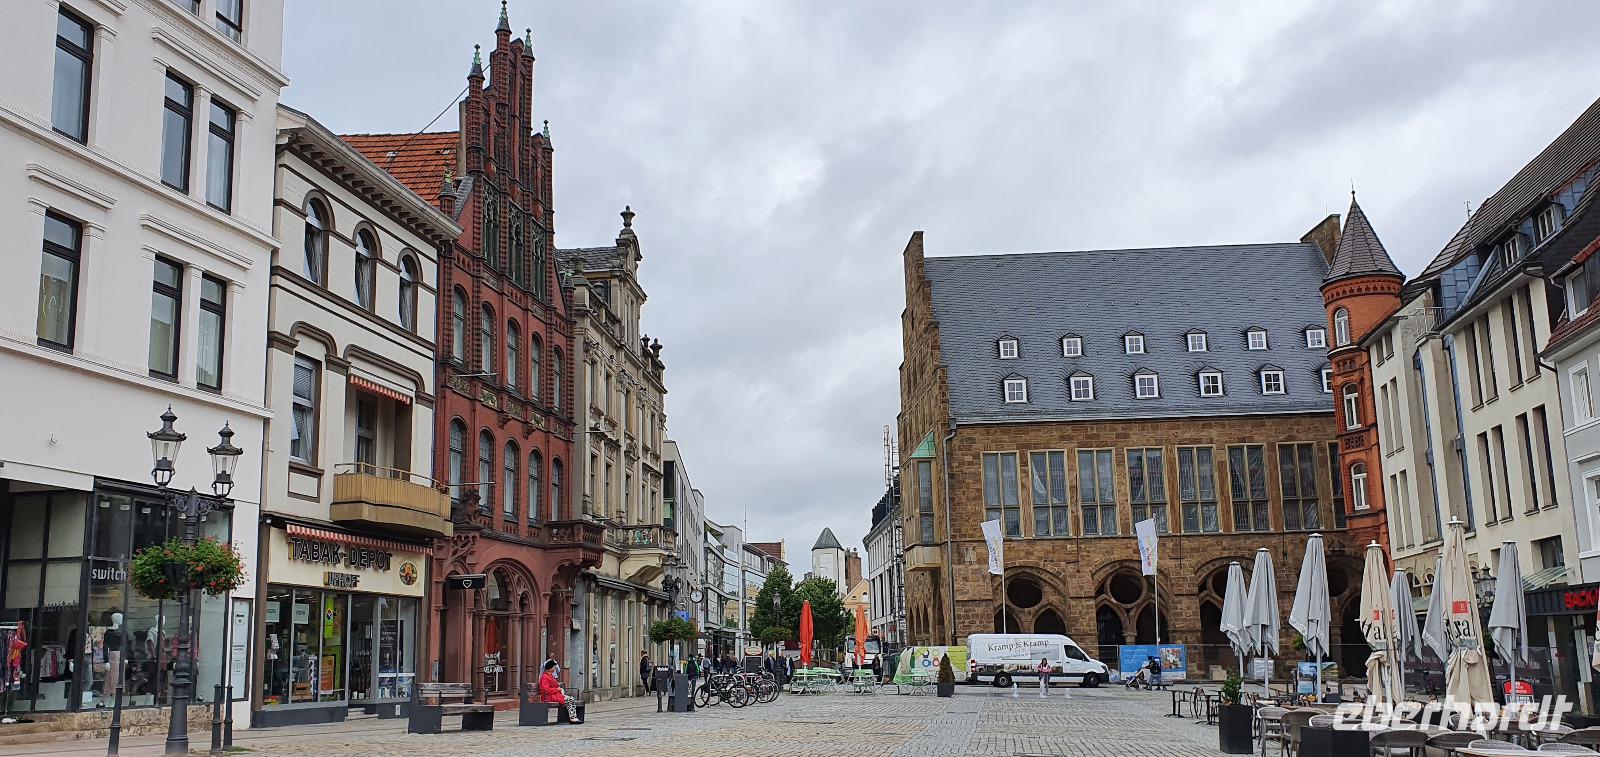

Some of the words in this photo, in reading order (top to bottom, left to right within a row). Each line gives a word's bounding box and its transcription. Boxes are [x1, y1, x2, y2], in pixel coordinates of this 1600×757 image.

[91, 567, 126, 581] switch
[988, 643, 1014, 652] Kramp
[1015, 641, 1022, 649] &
[1023, 639, 1050, 648] Kramp
